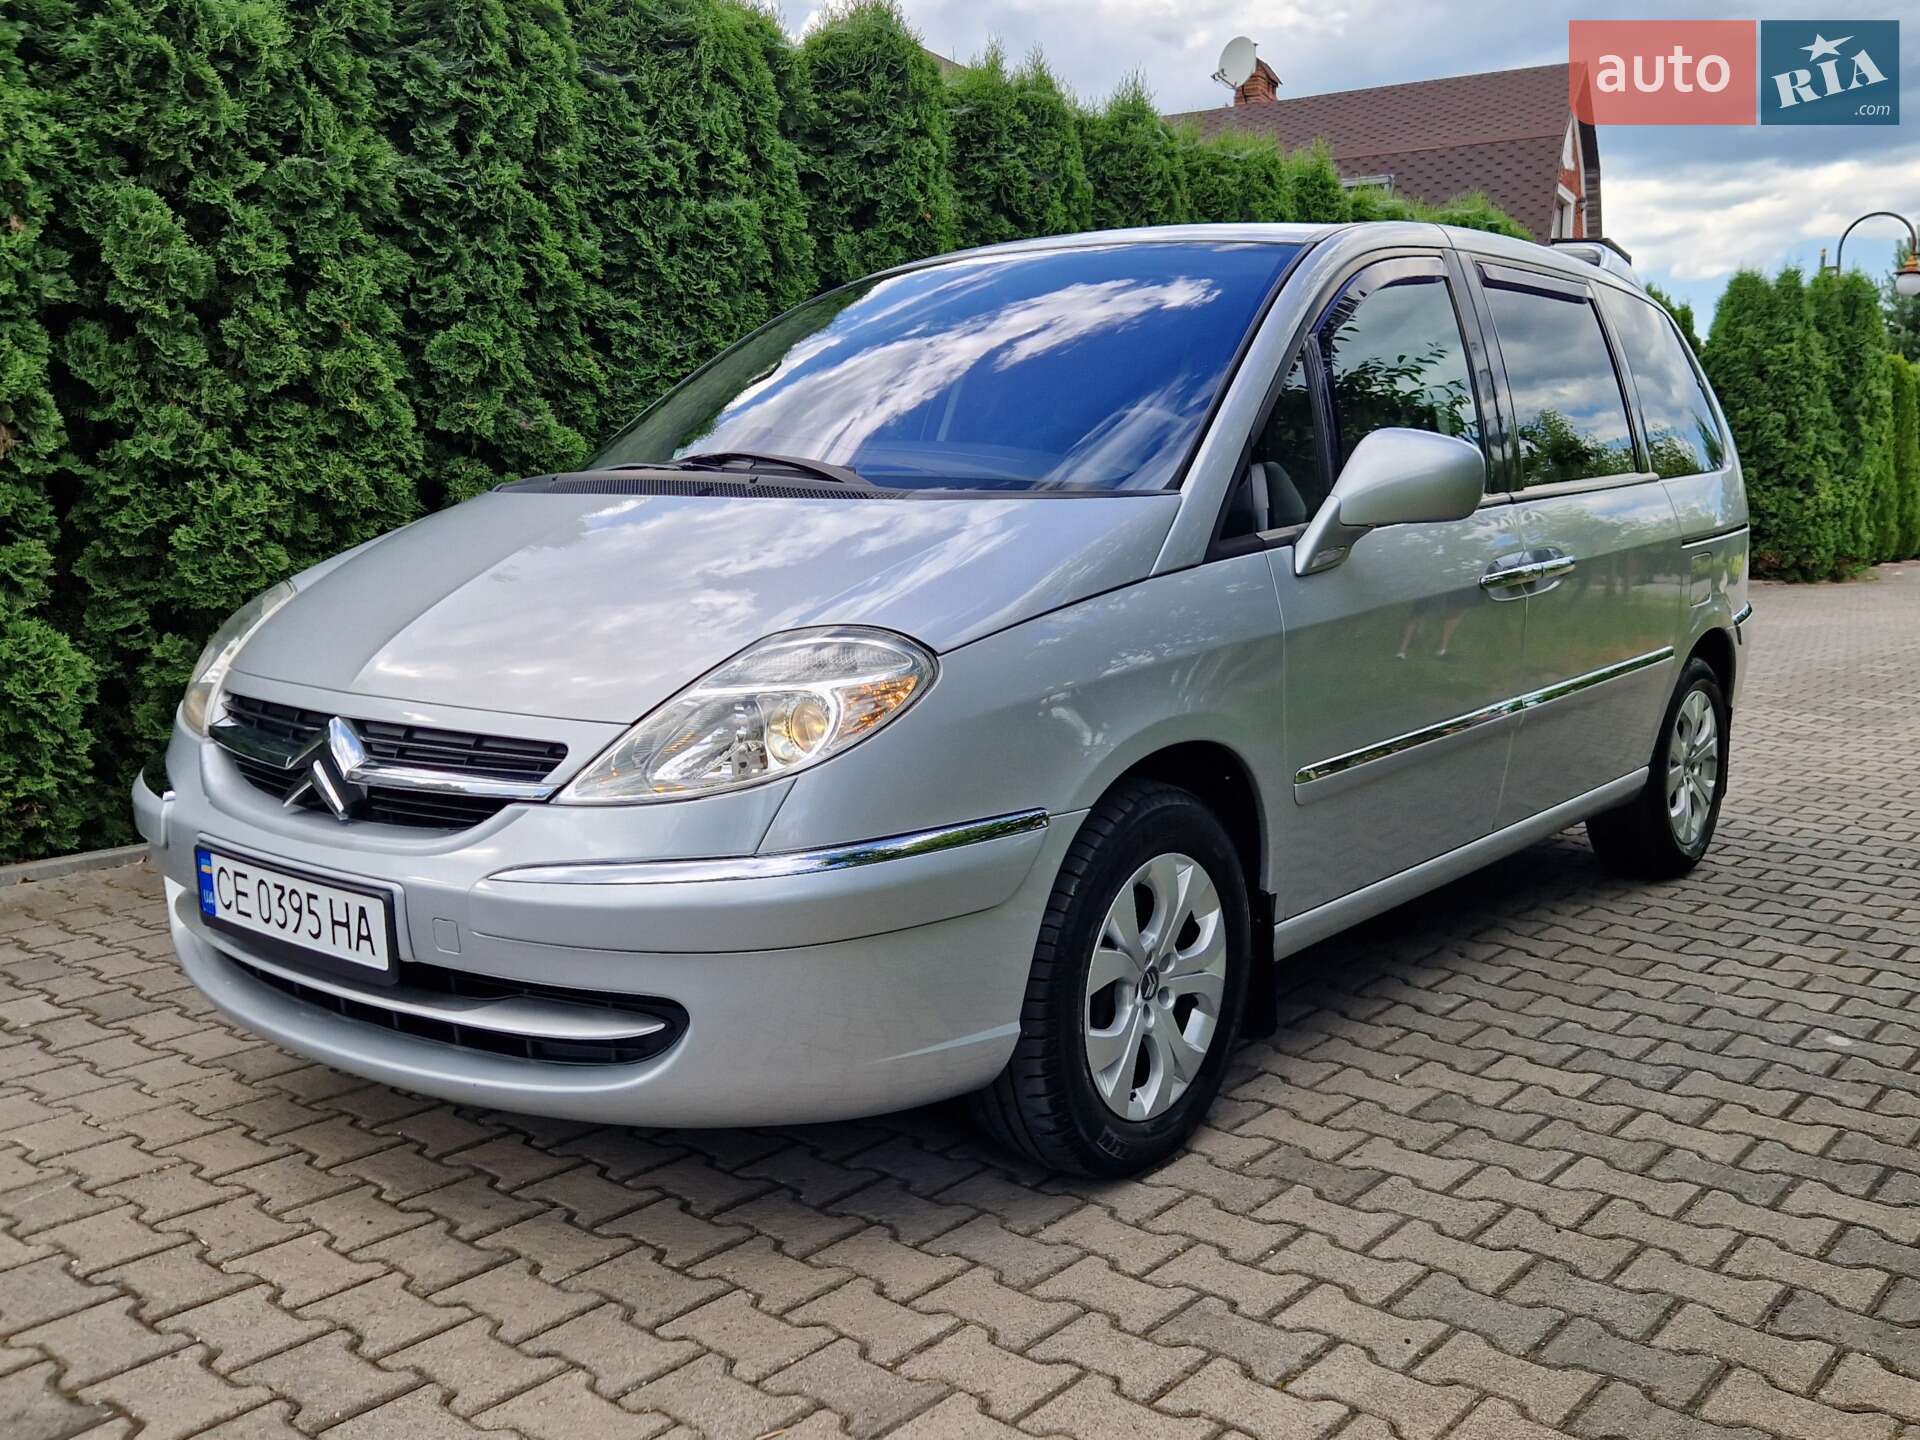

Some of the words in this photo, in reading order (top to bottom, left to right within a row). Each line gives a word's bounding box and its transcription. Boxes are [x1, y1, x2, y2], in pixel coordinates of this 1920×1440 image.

[217, 866, 252, 918] CE
[257, 878, 322, 939] 0395
[328, 897, 376, 956] HA
